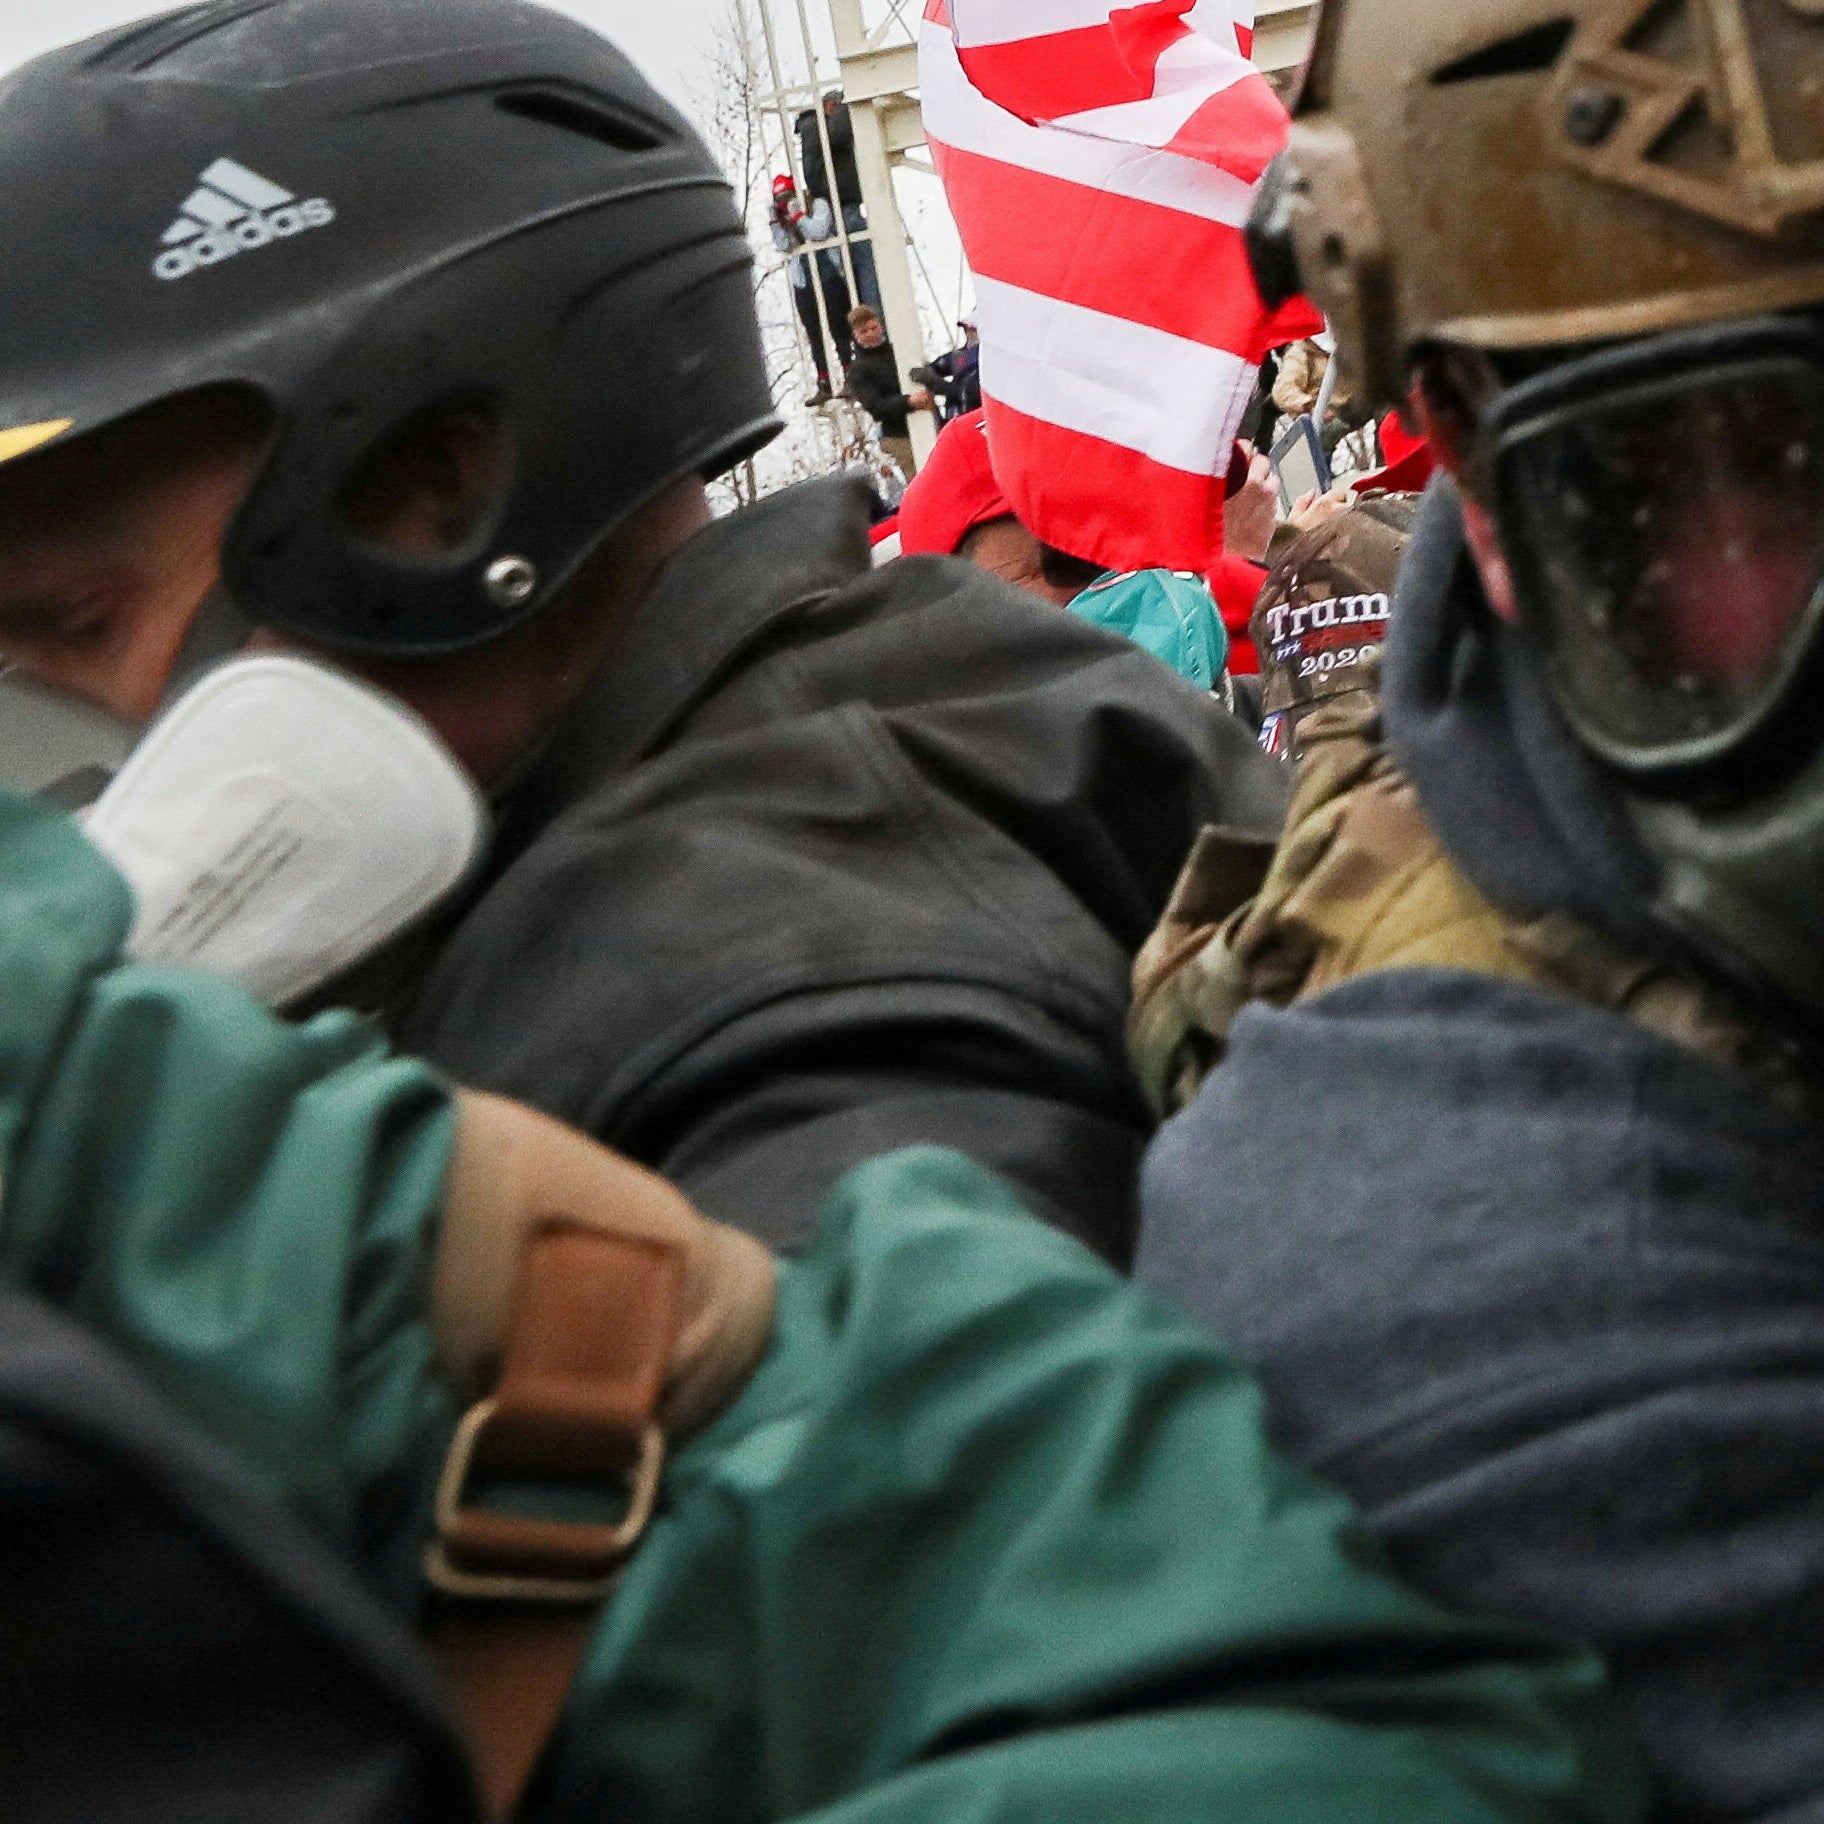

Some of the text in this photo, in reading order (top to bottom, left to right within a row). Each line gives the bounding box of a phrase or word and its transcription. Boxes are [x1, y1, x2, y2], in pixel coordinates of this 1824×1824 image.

[152, 196, 337, 281] adidas
[1266, 591, 1393, 646] Trum
[1298, 644, 1379, 679] 2020
